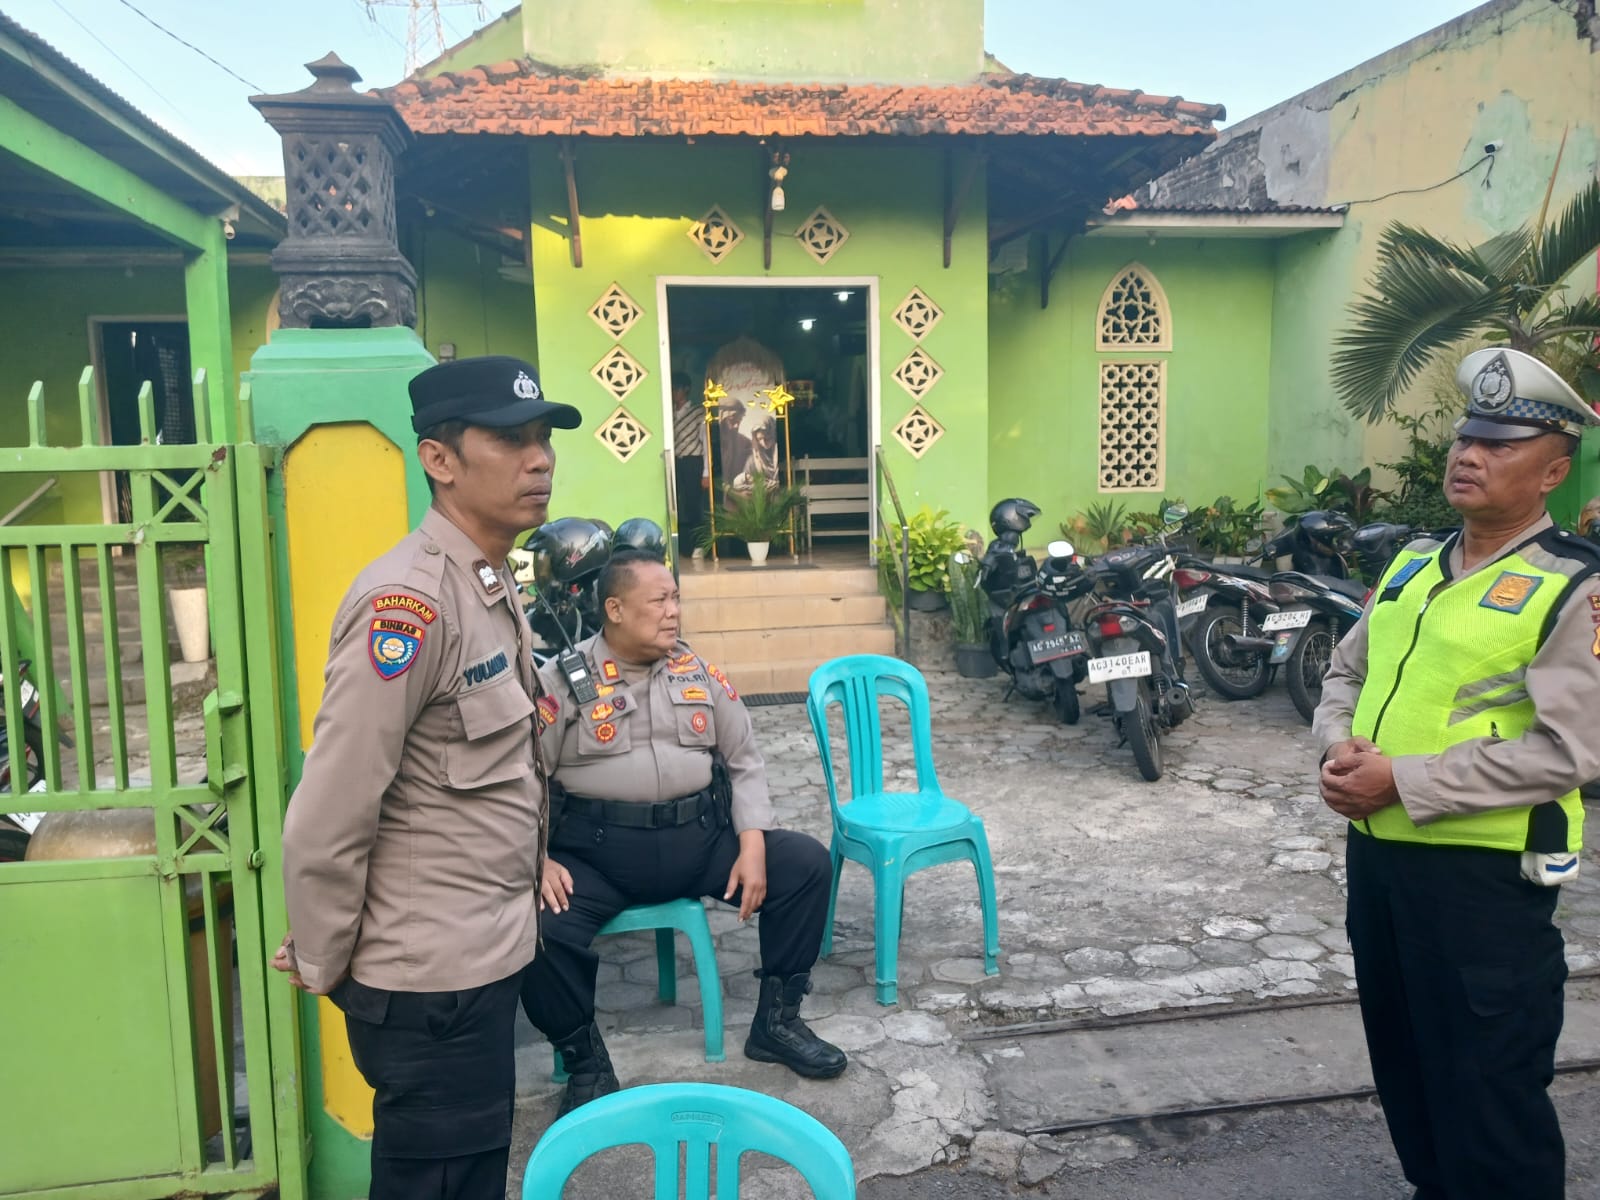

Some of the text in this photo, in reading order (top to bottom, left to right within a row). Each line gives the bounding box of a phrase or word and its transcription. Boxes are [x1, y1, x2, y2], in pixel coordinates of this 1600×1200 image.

[375, 596, 433, 624] BAHARKAM
[380, 620, 417, 635] BINMAS
[667, 673, 708, 684] POLRI
